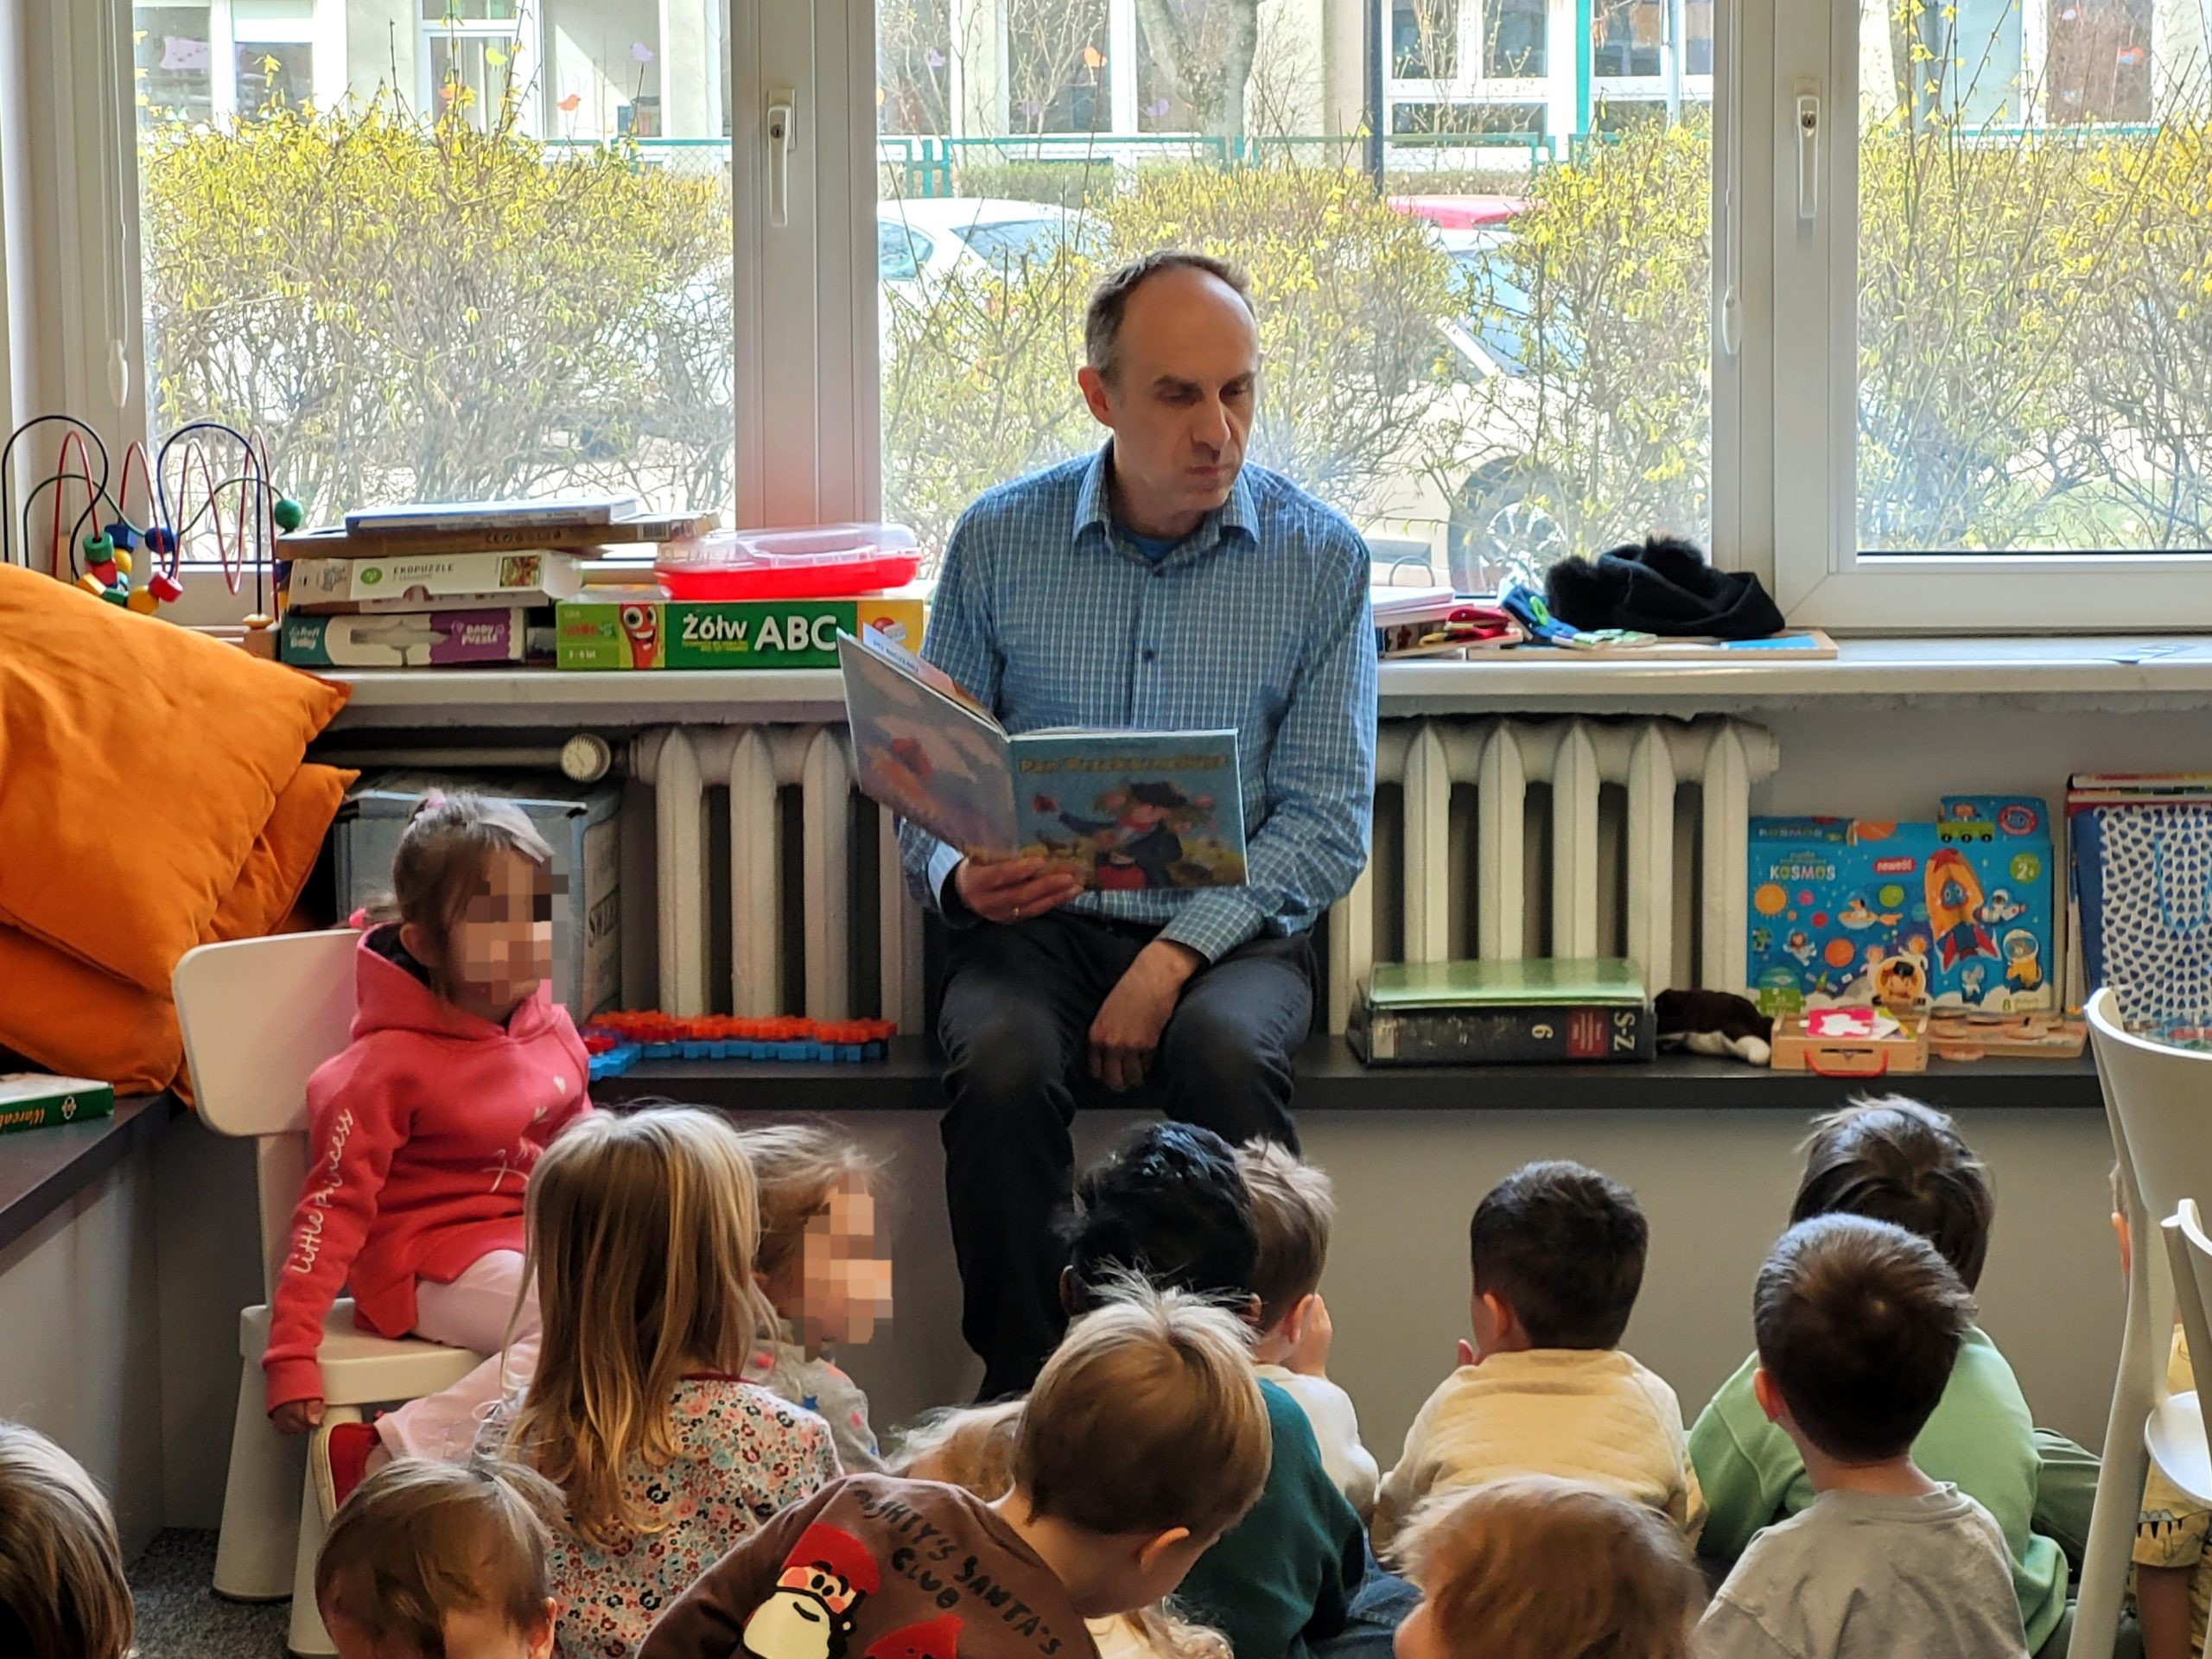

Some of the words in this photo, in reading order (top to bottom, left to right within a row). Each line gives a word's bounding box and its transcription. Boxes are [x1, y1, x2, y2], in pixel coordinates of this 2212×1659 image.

[393, 563, 454, 574] EKOPUZZLE
[682, 613, 747, 639] Żółw
[754, 614, 837, 652] ABC
[1770, 865, 1835, 880] KOSMOS
[1613, 1012, 1636, 1051] S-Z
